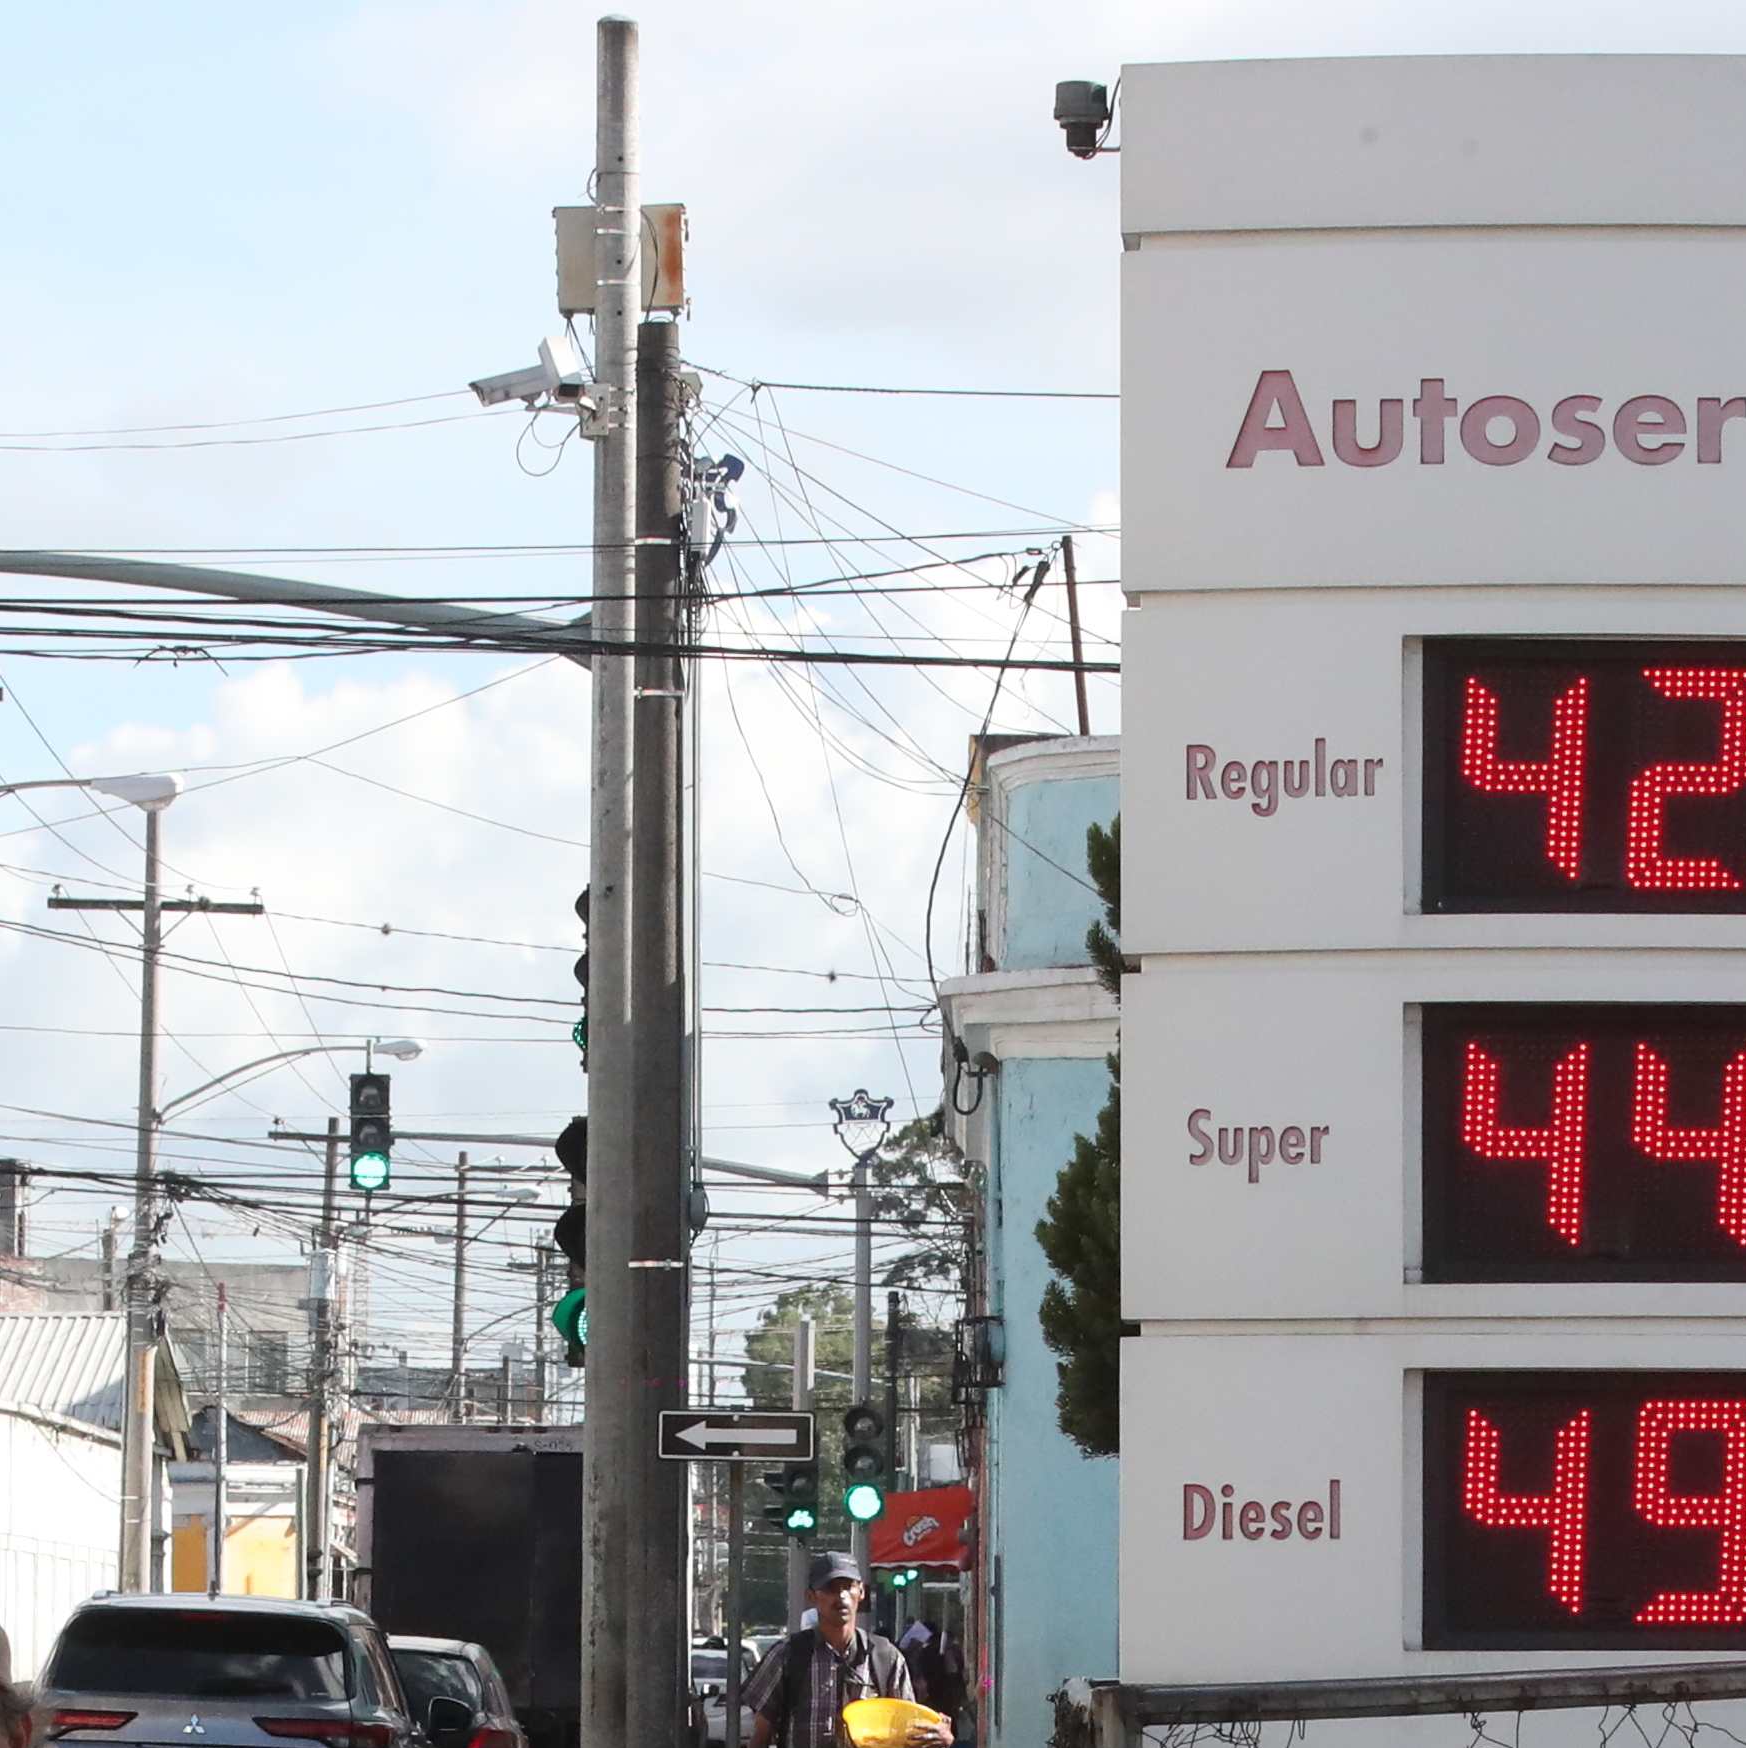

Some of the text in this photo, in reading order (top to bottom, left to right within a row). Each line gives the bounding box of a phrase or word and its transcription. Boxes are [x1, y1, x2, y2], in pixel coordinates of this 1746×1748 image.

[1184, 738, 1384, 818] Regular
[1187, 1107, 1331, 1185] Super
[1181, 1478, 1343, 1543] Diesel
